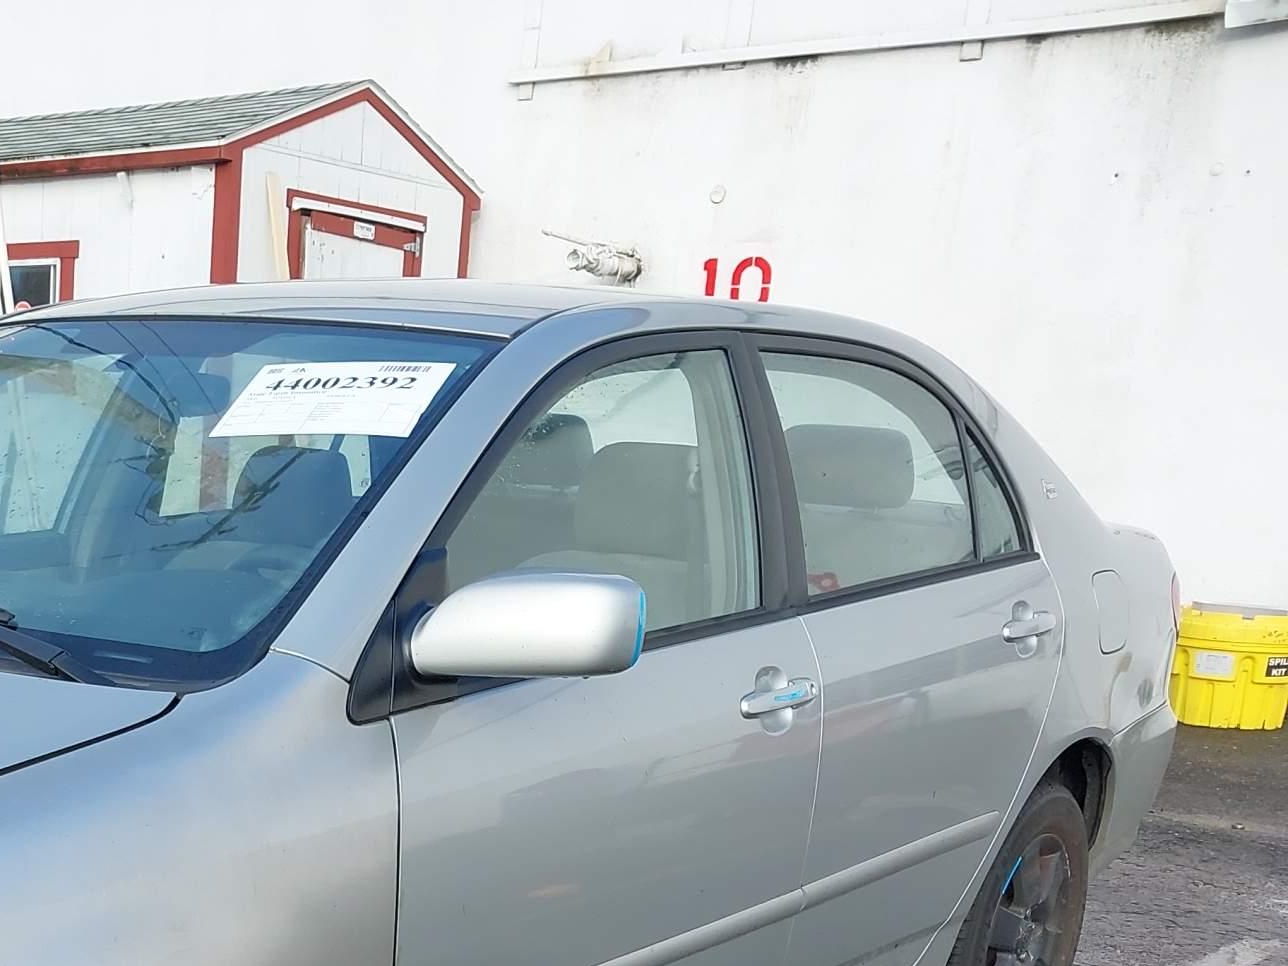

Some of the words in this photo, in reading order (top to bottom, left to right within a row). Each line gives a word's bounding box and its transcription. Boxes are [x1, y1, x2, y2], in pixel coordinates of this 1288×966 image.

[703, 256, 772, 302] 10
[265, 376, 418, 391] 44002392
[1269, 658, 1288, 666] SPIL
[1272, 668, 1287, 676] KIT
